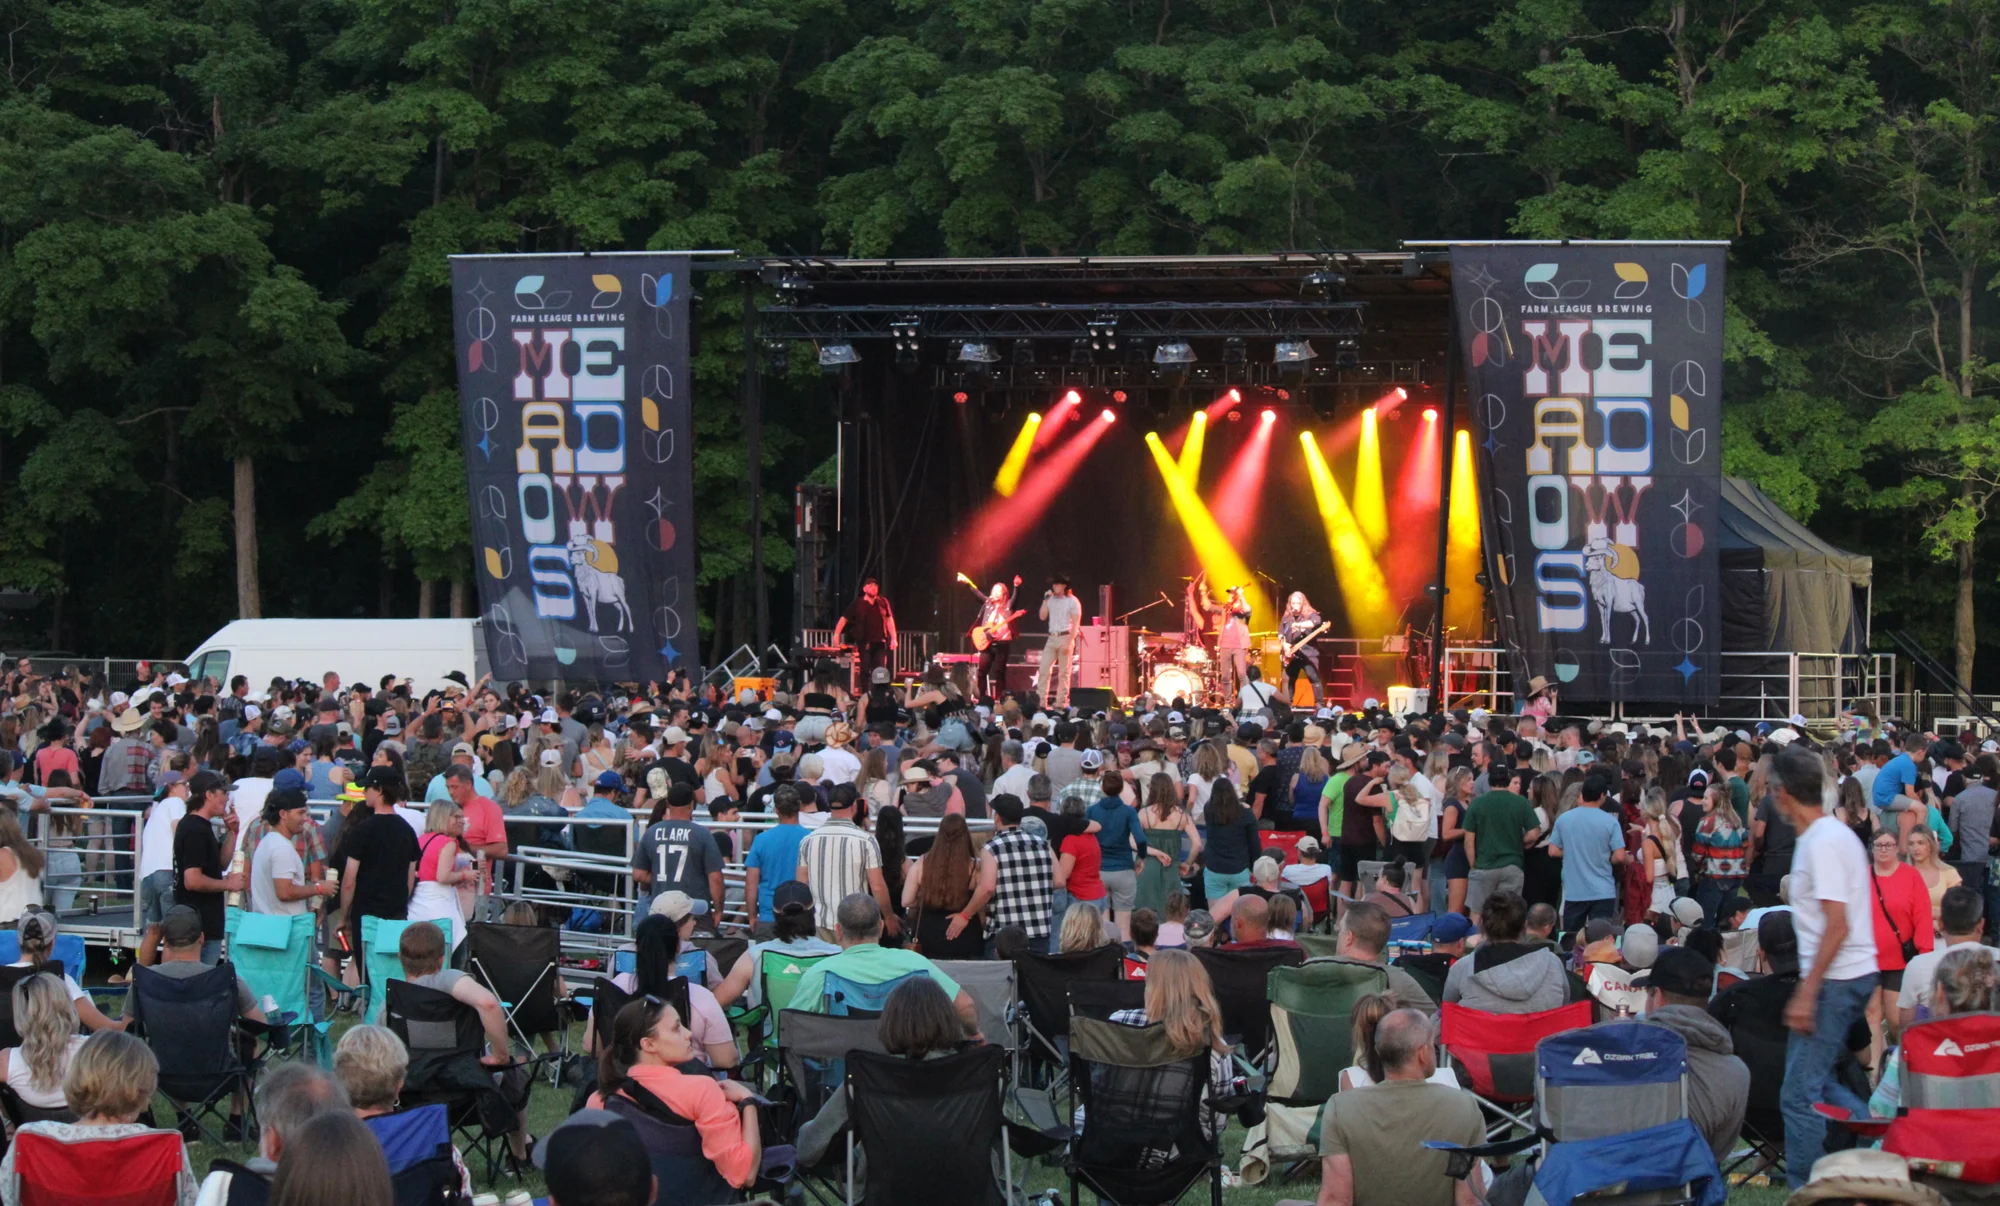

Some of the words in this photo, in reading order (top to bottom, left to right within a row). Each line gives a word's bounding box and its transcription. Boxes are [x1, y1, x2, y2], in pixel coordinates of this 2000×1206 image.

[1520, 305, 1549, 314] FARM
[1553, 305, 1592, 313] LEAGUE
[1597, 304, 1653, 313] BREWING
[510, 314, 535, 323] FARM
[538, 314, 573, 322] LEAGUE
[575, 313, 626, 322] BREWING
[655, 827, 692, 842] CLARK
[656, 844, 689, 883] 17
